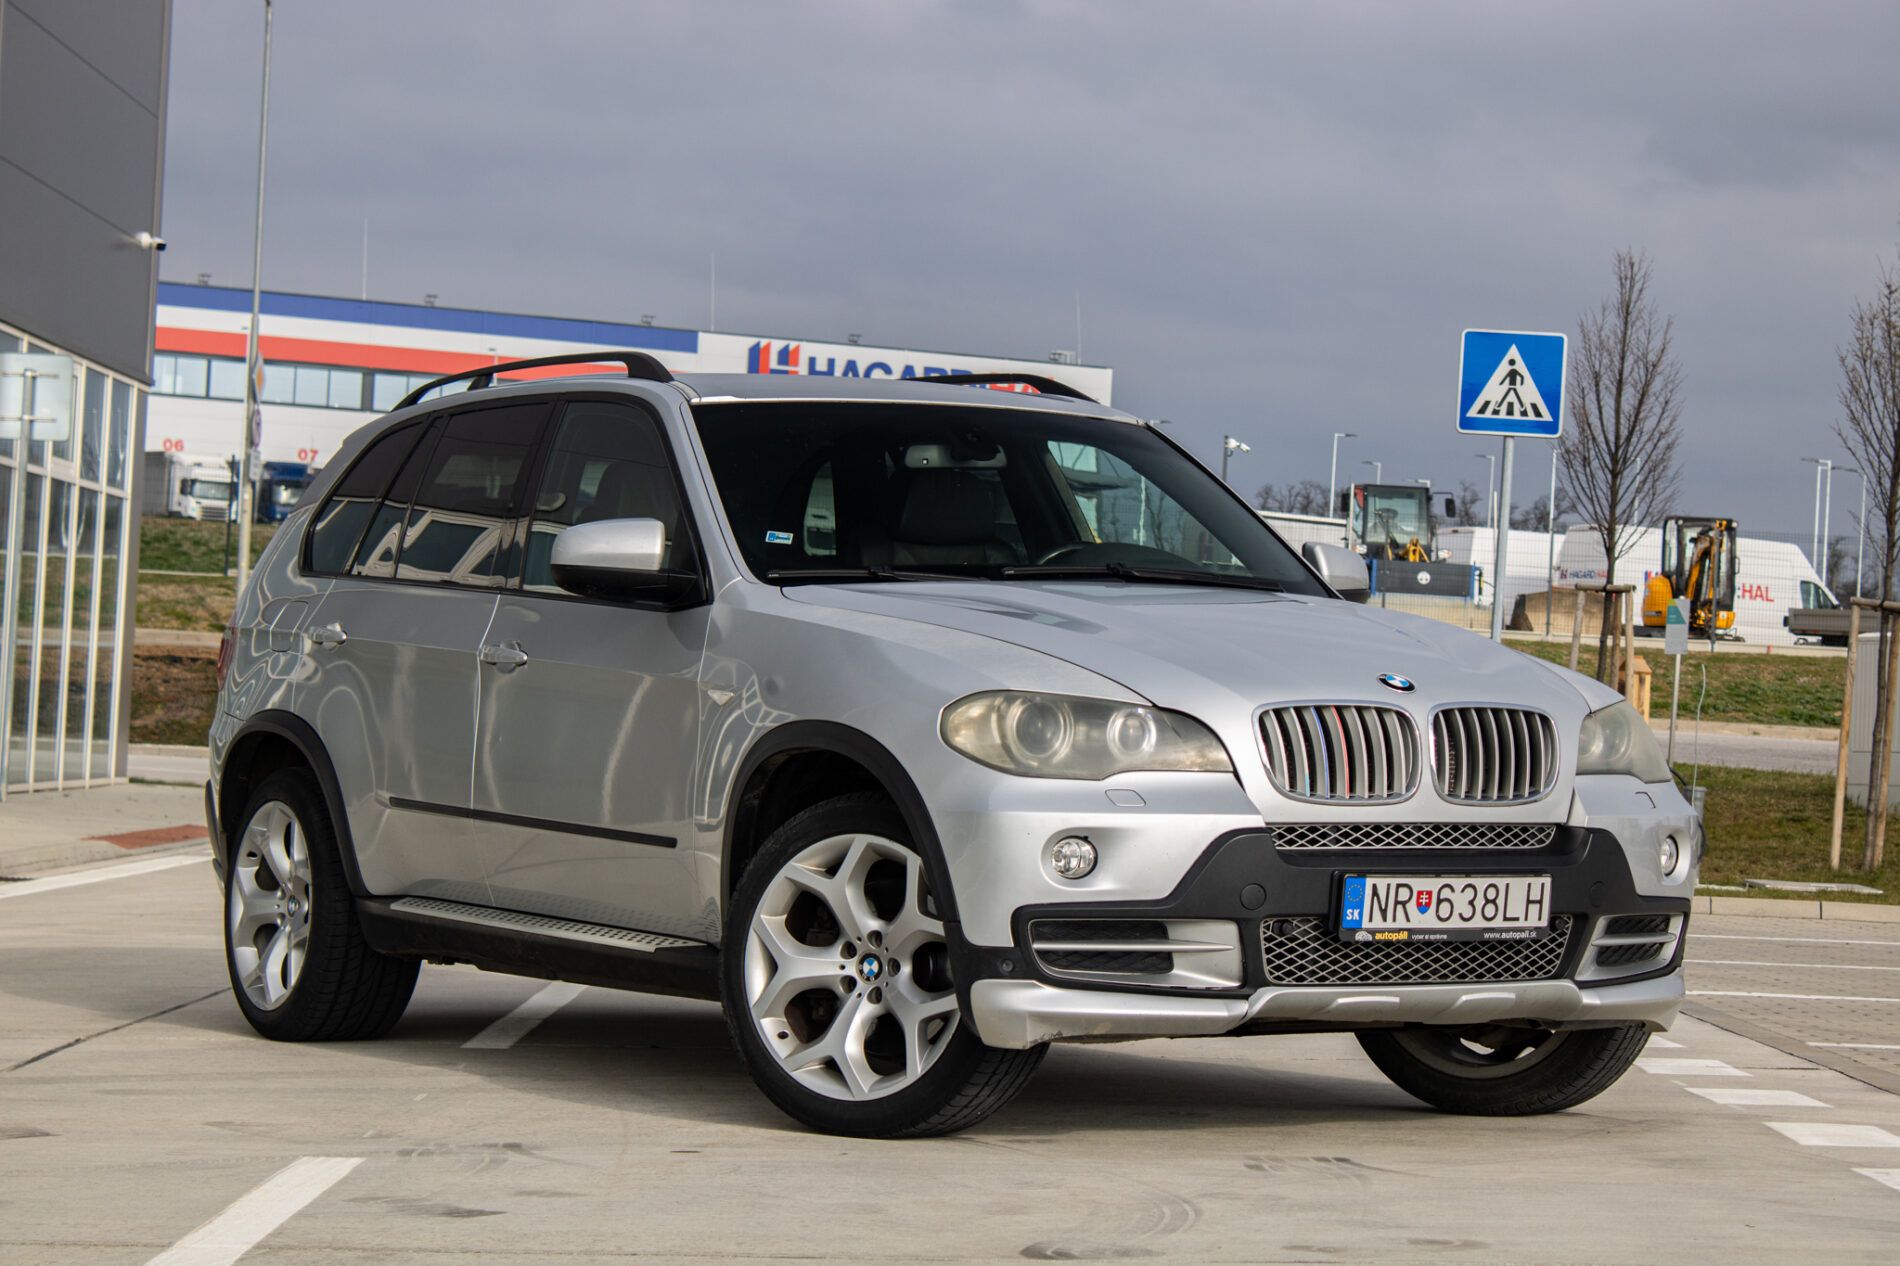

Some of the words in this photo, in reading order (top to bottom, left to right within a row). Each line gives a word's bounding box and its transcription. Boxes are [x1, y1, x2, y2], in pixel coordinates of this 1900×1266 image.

[163, 438, 184, 452] 06
[298, 448, 318, 462] 07
[1741, 583, 1775, 602] HAL
[1368, 882, 1414, 923] NR
[1435, 882, 1545, 922] 638LH
[1346, 909, 1360, 921] SK
[1483, 930, 1536, 940] www.autopall.sk
